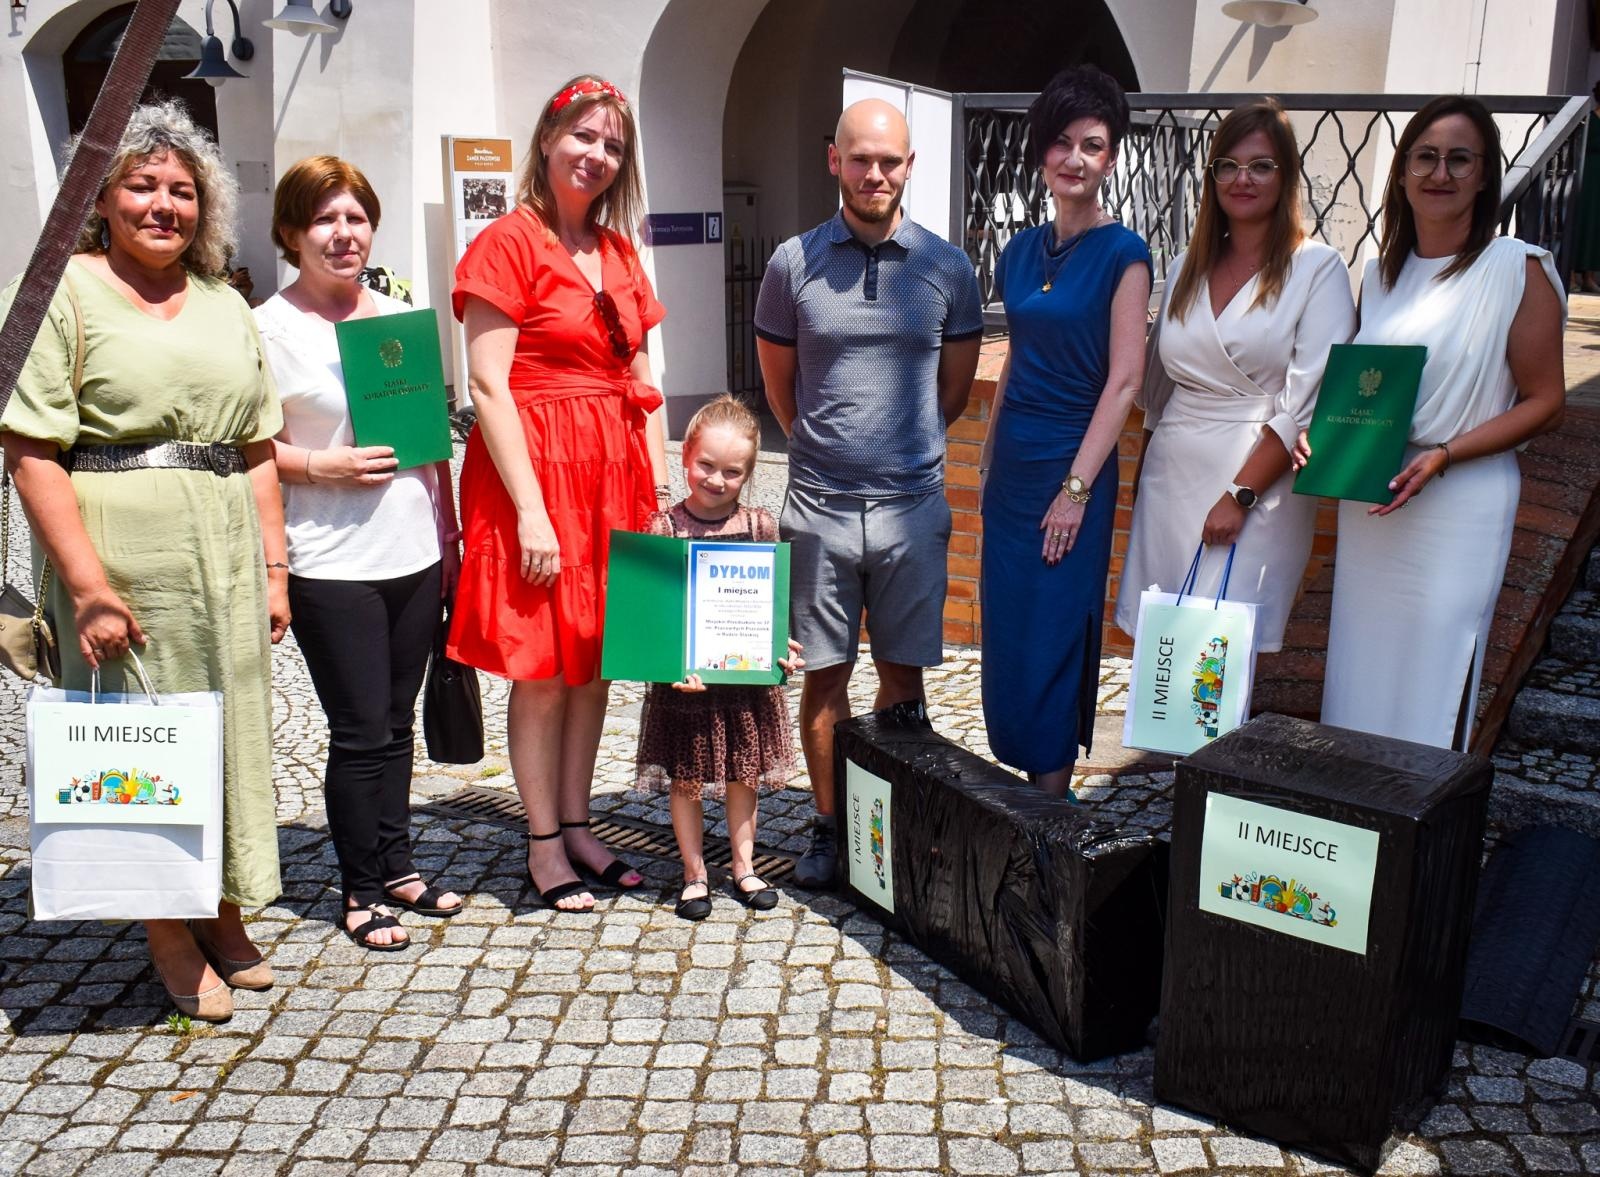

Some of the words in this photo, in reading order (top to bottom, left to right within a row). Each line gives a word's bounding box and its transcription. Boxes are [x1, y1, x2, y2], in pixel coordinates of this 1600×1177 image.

[363, 389, 397, 400] KURATOR
[1327, 415, 1360, 424] KURATOR
[709, 565, 770, 579] DYPLOM
[724, 587, 758, 595] miejsca
[1153, 635, 1175, 706] MIEJSCE
[1152, 710, 1167, 720] II
[69, 725, 86, 742] III
[94, 725, 178, 744] MIEJSCE
[853, 792, 862, 856] MIEJSCE
[1237, 821, 1250, 840] II
[1255, 825, 1339, 863] MIEJSCE
